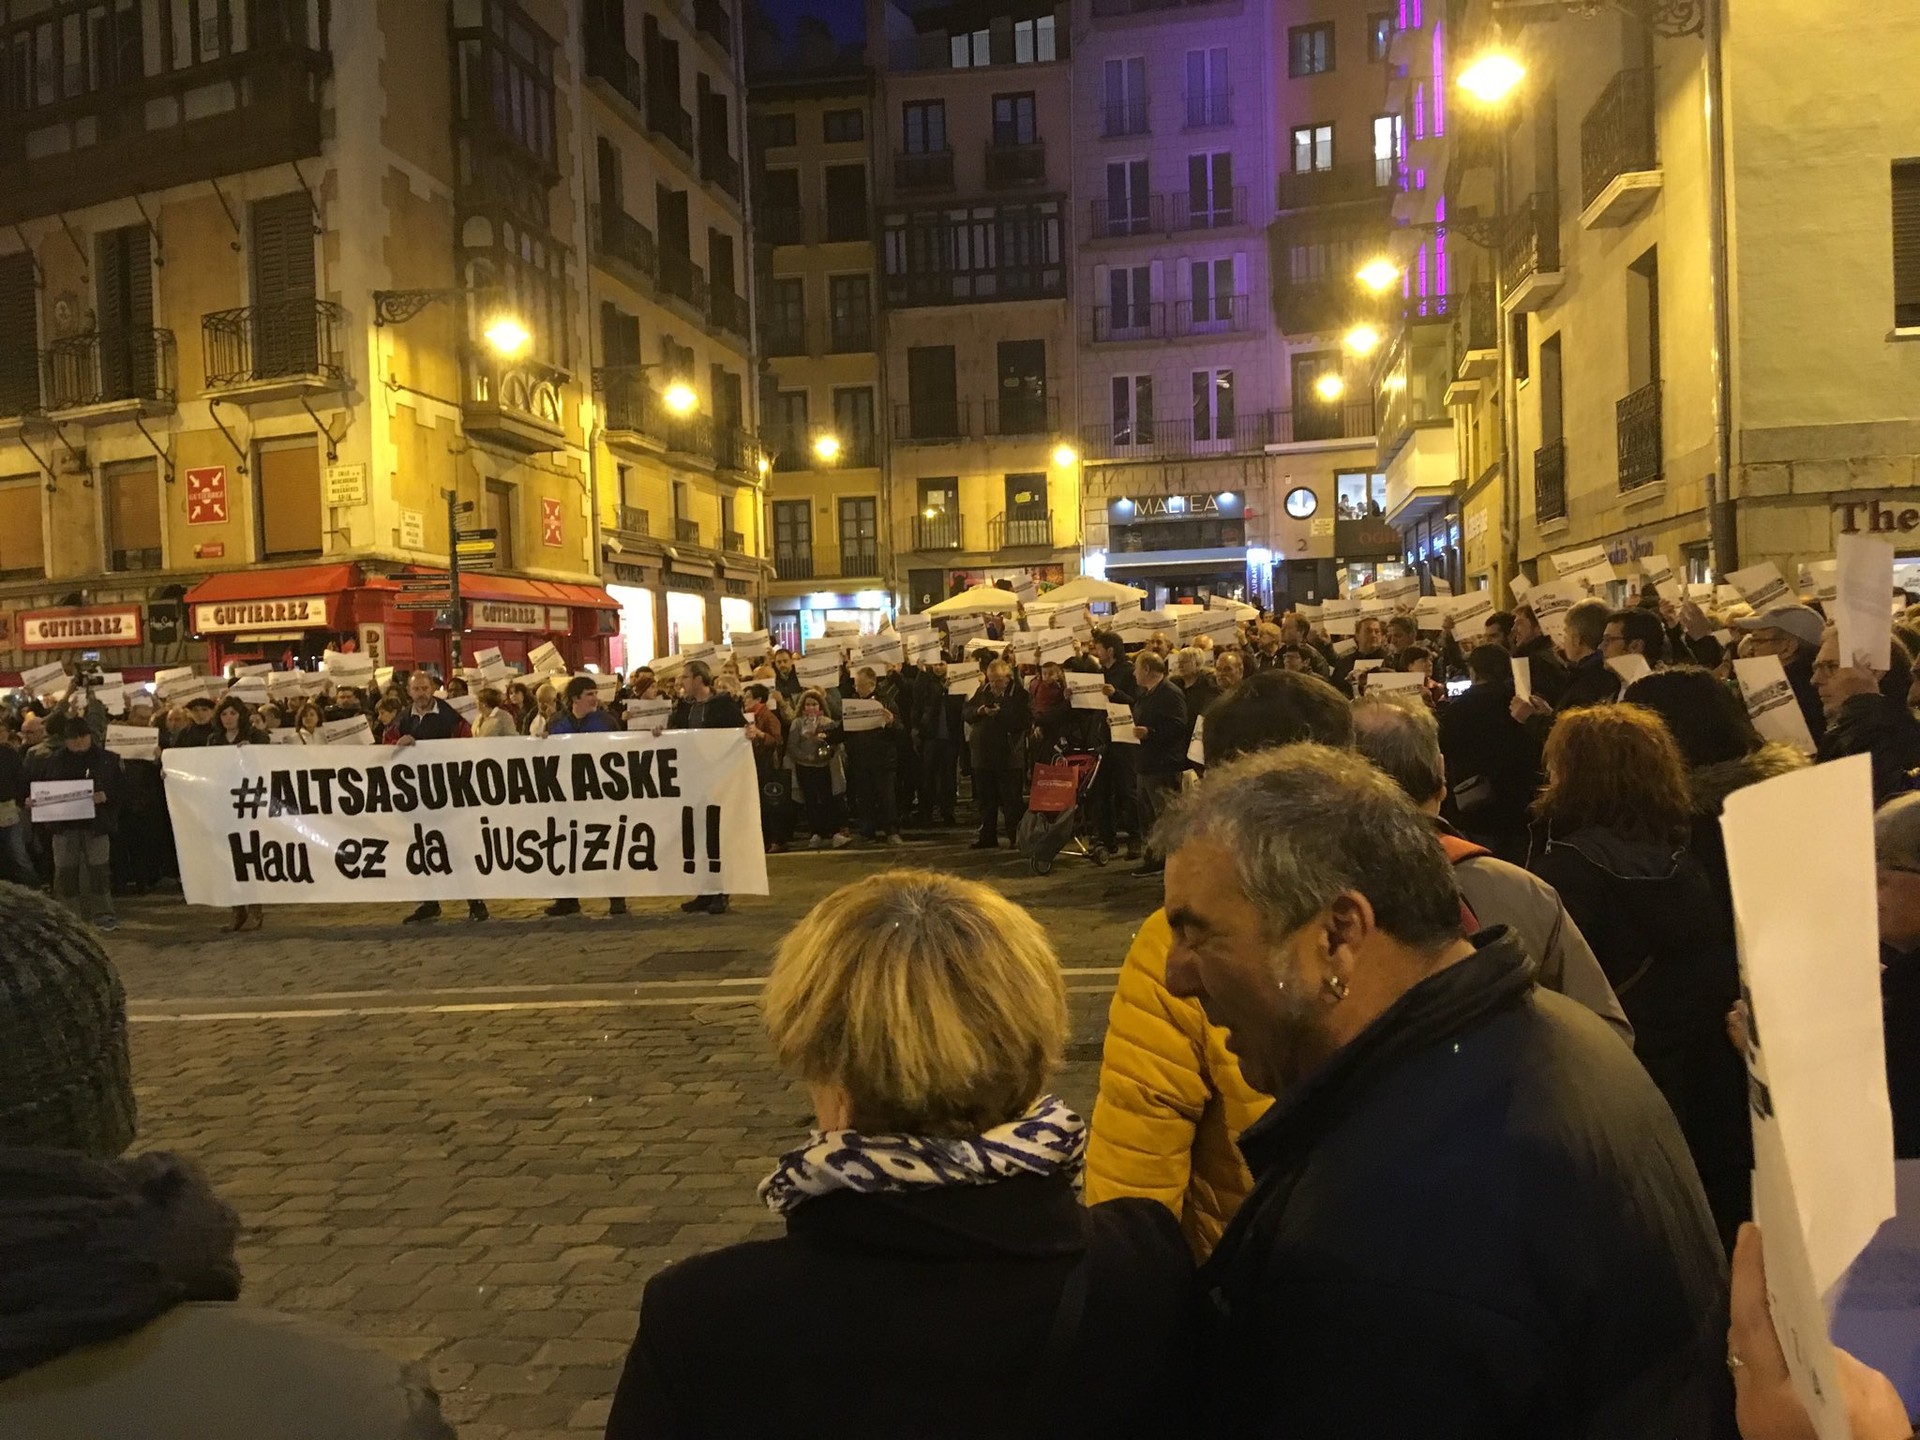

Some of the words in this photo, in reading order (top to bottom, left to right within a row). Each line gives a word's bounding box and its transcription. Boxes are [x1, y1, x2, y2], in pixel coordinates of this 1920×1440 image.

[1134, 494, 1219, 517] MALTEA
[1829, 500, 1920, 534] The
[1298, 538, 1307, 551] 2
[923, 594, 931, 604] 6
[213, 602, 309, 625] GUTIERREZ
[482, 605, 536, 624] GUTIERREZ
[38, 617, 122, 638] GUTIERREZ
[230, 755, 567, 819] #ALTSASUKOAK
[571, 748, 681, 801] ASKE
[228, 830, 314, 884] Hau
[335, 838, 389, 879] ez
[406, 823, 452, 876] da
[474, 815, 658, 876] justizia
[682, 805, 721, 874] !!
